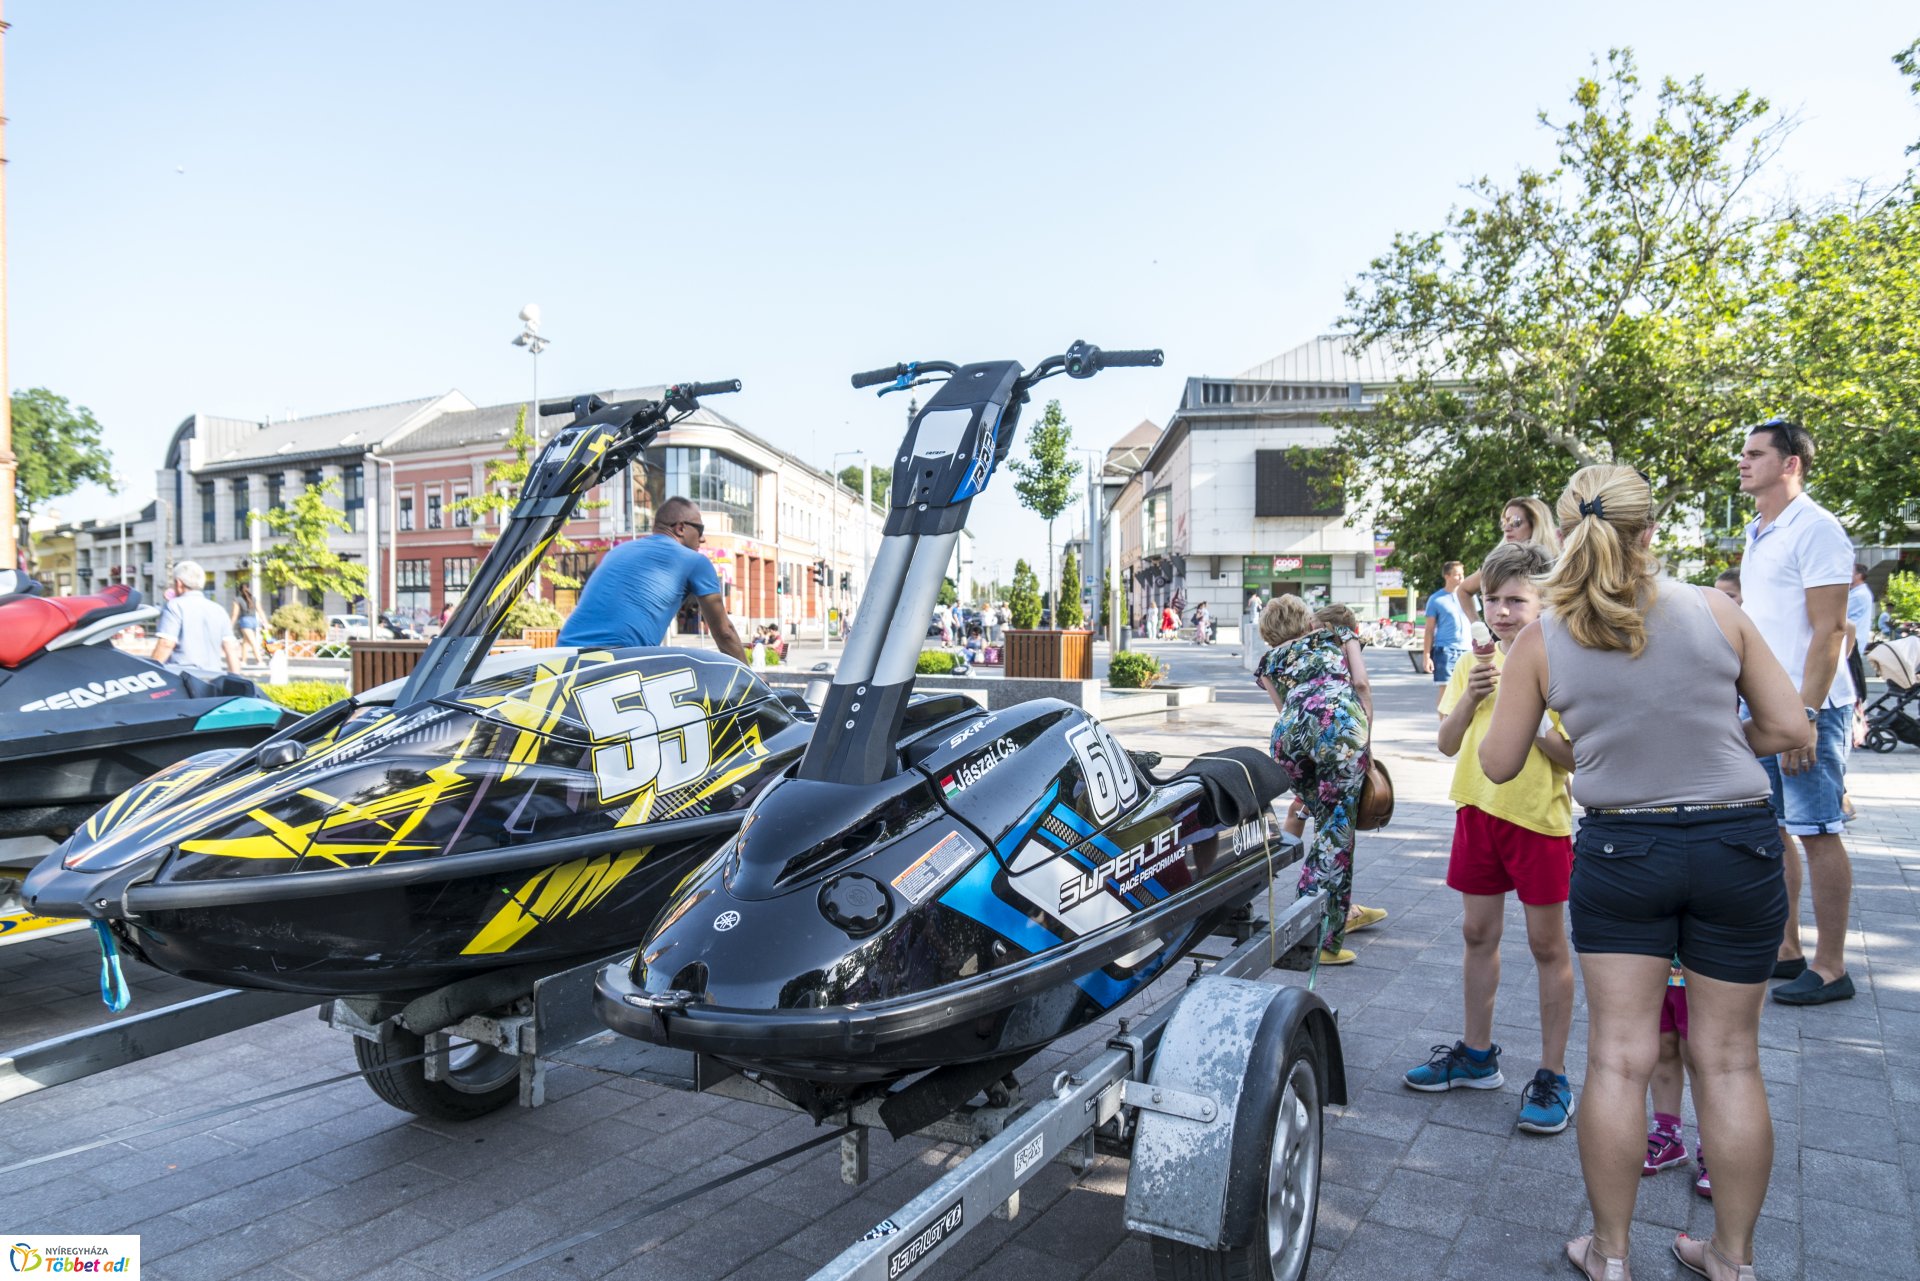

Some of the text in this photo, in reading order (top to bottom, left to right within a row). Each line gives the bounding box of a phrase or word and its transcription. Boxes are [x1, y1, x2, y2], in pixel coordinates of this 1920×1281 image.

[1275, 558, 1300, 569] coop
[570, 668, 712, 804] 55
[956, 737, 1020, 791] Jászai Cs.
[1065, 717, 1138, 825] 60
[1059, 822, 1182, 914] SUPERJET
[1120, 846, 1186, 896] RACE PERFORMANCE
[890, 1216, 947, 1279] JETPILOT
